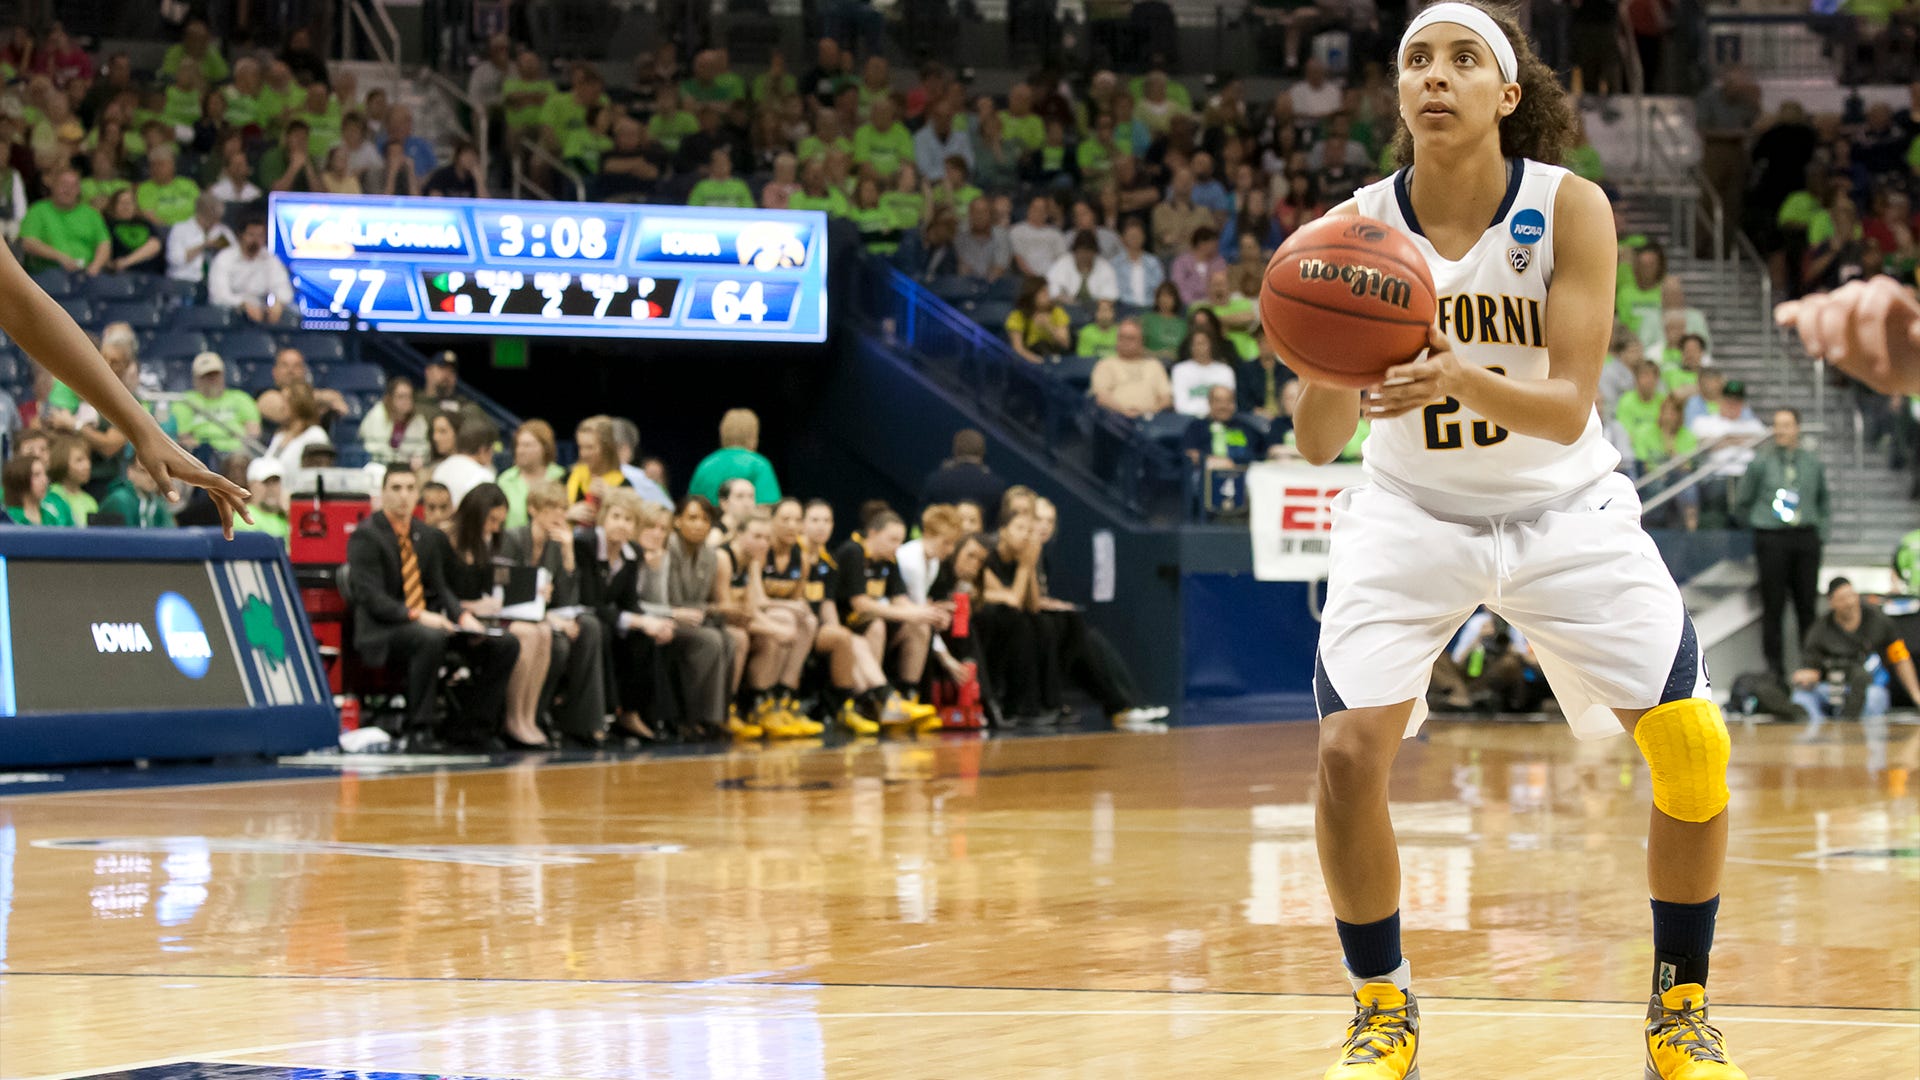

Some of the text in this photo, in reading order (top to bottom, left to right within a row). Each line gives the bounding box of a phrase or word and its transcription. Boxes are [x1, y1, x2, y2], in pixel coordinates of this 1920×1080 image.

[499, 214, 608, 259] 3:08
[1514, 223, 1543, 236] NCAA
[329, 268, 386, 314] 77
[488, 286, 616, 320] 7 2 7
[711, 280, 768, 324] 64
[1300, 259, 1411, 309] Wilson
[1220, 477, 1236, 499] 4
[91, 622, 153, 653] IOWA
